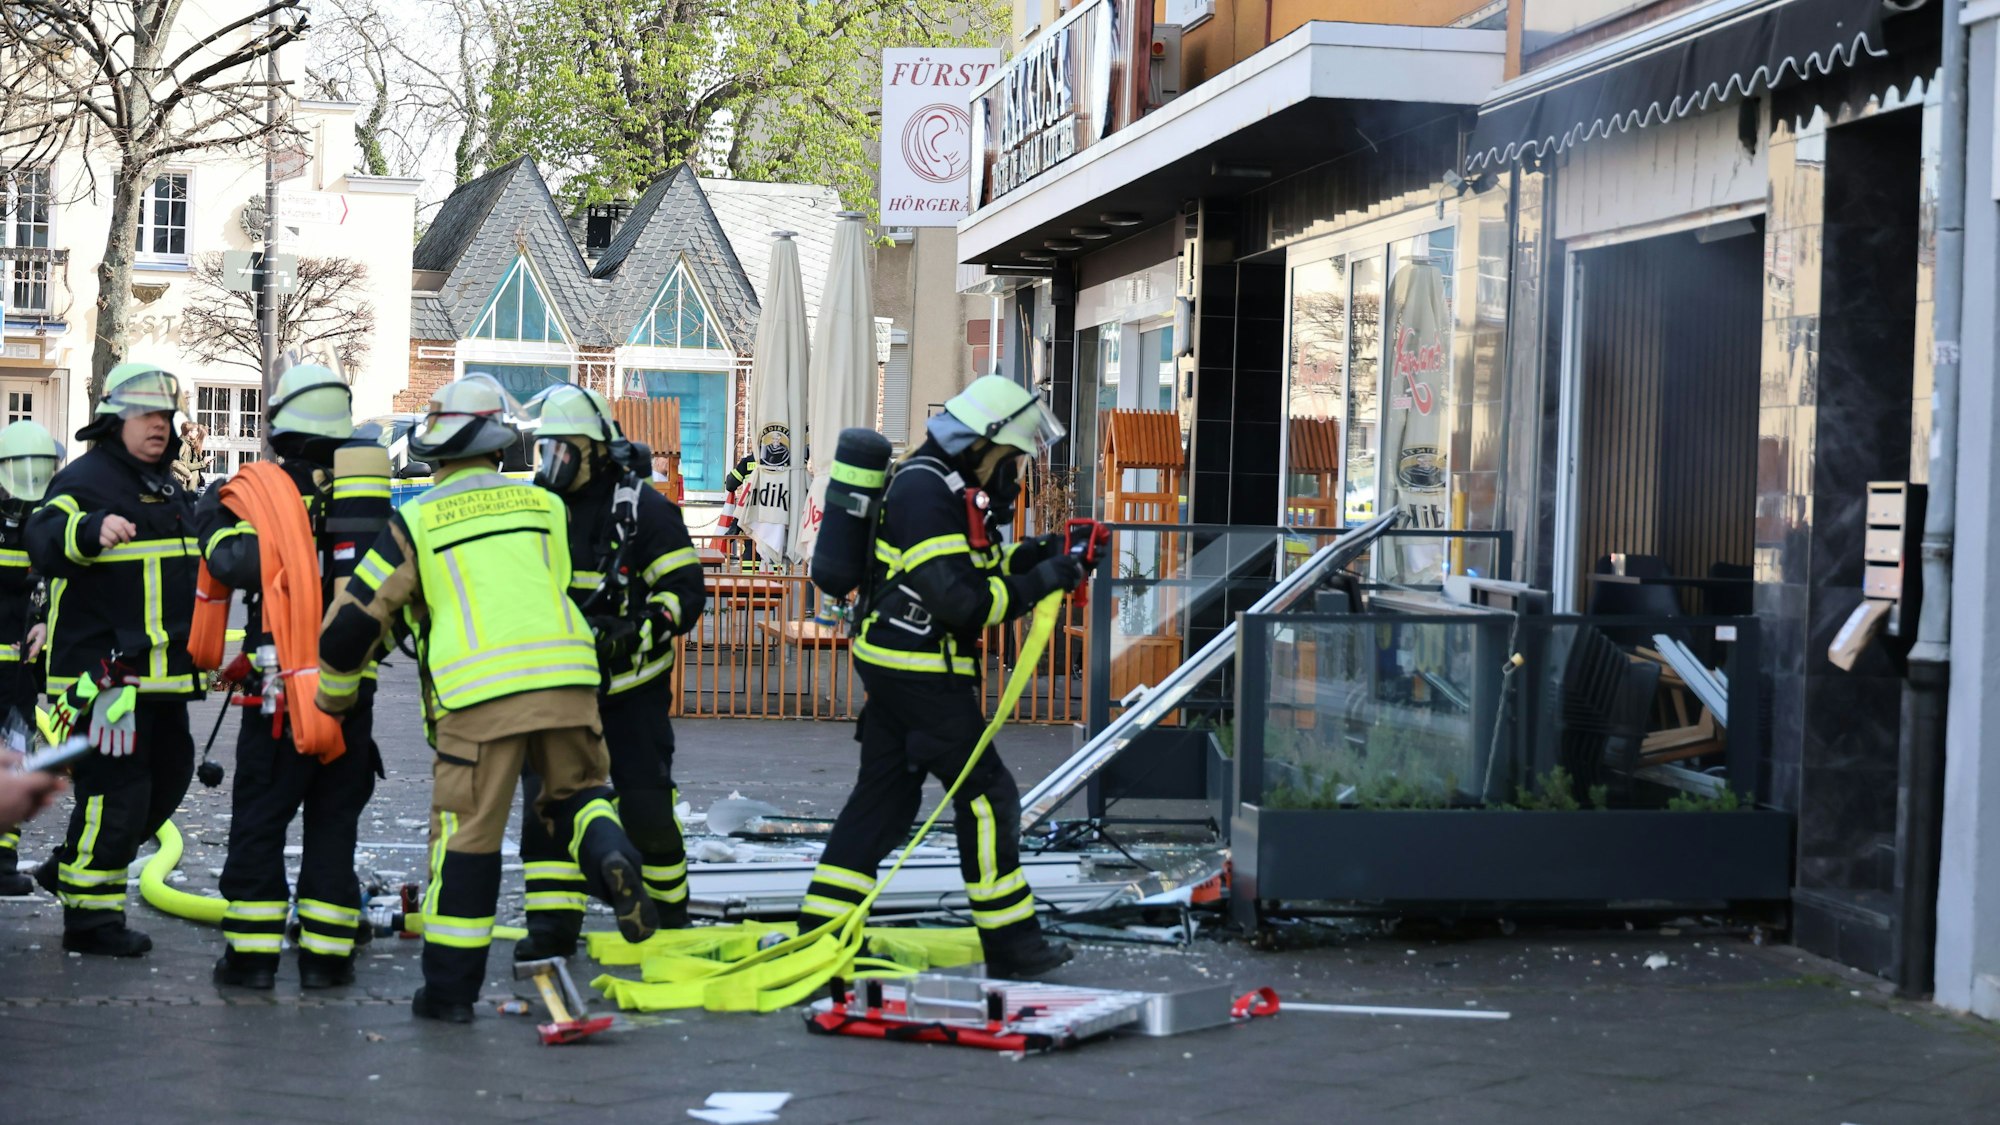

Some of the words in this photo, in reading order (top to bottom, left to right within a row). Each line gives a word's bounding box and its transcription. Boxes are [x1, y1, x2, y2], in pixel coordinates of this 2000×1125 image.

[889, 57, 995, 87] FÜRST
[1000, 28, 1069, 155] ASAKUSA
[5, 343, 35, 358] TEL
[435, 511, 456, 523] FW
[460, 497, 541, 517] EUSKIRCHEN
[436, 487, 533, 511] EINSATZLEITER
